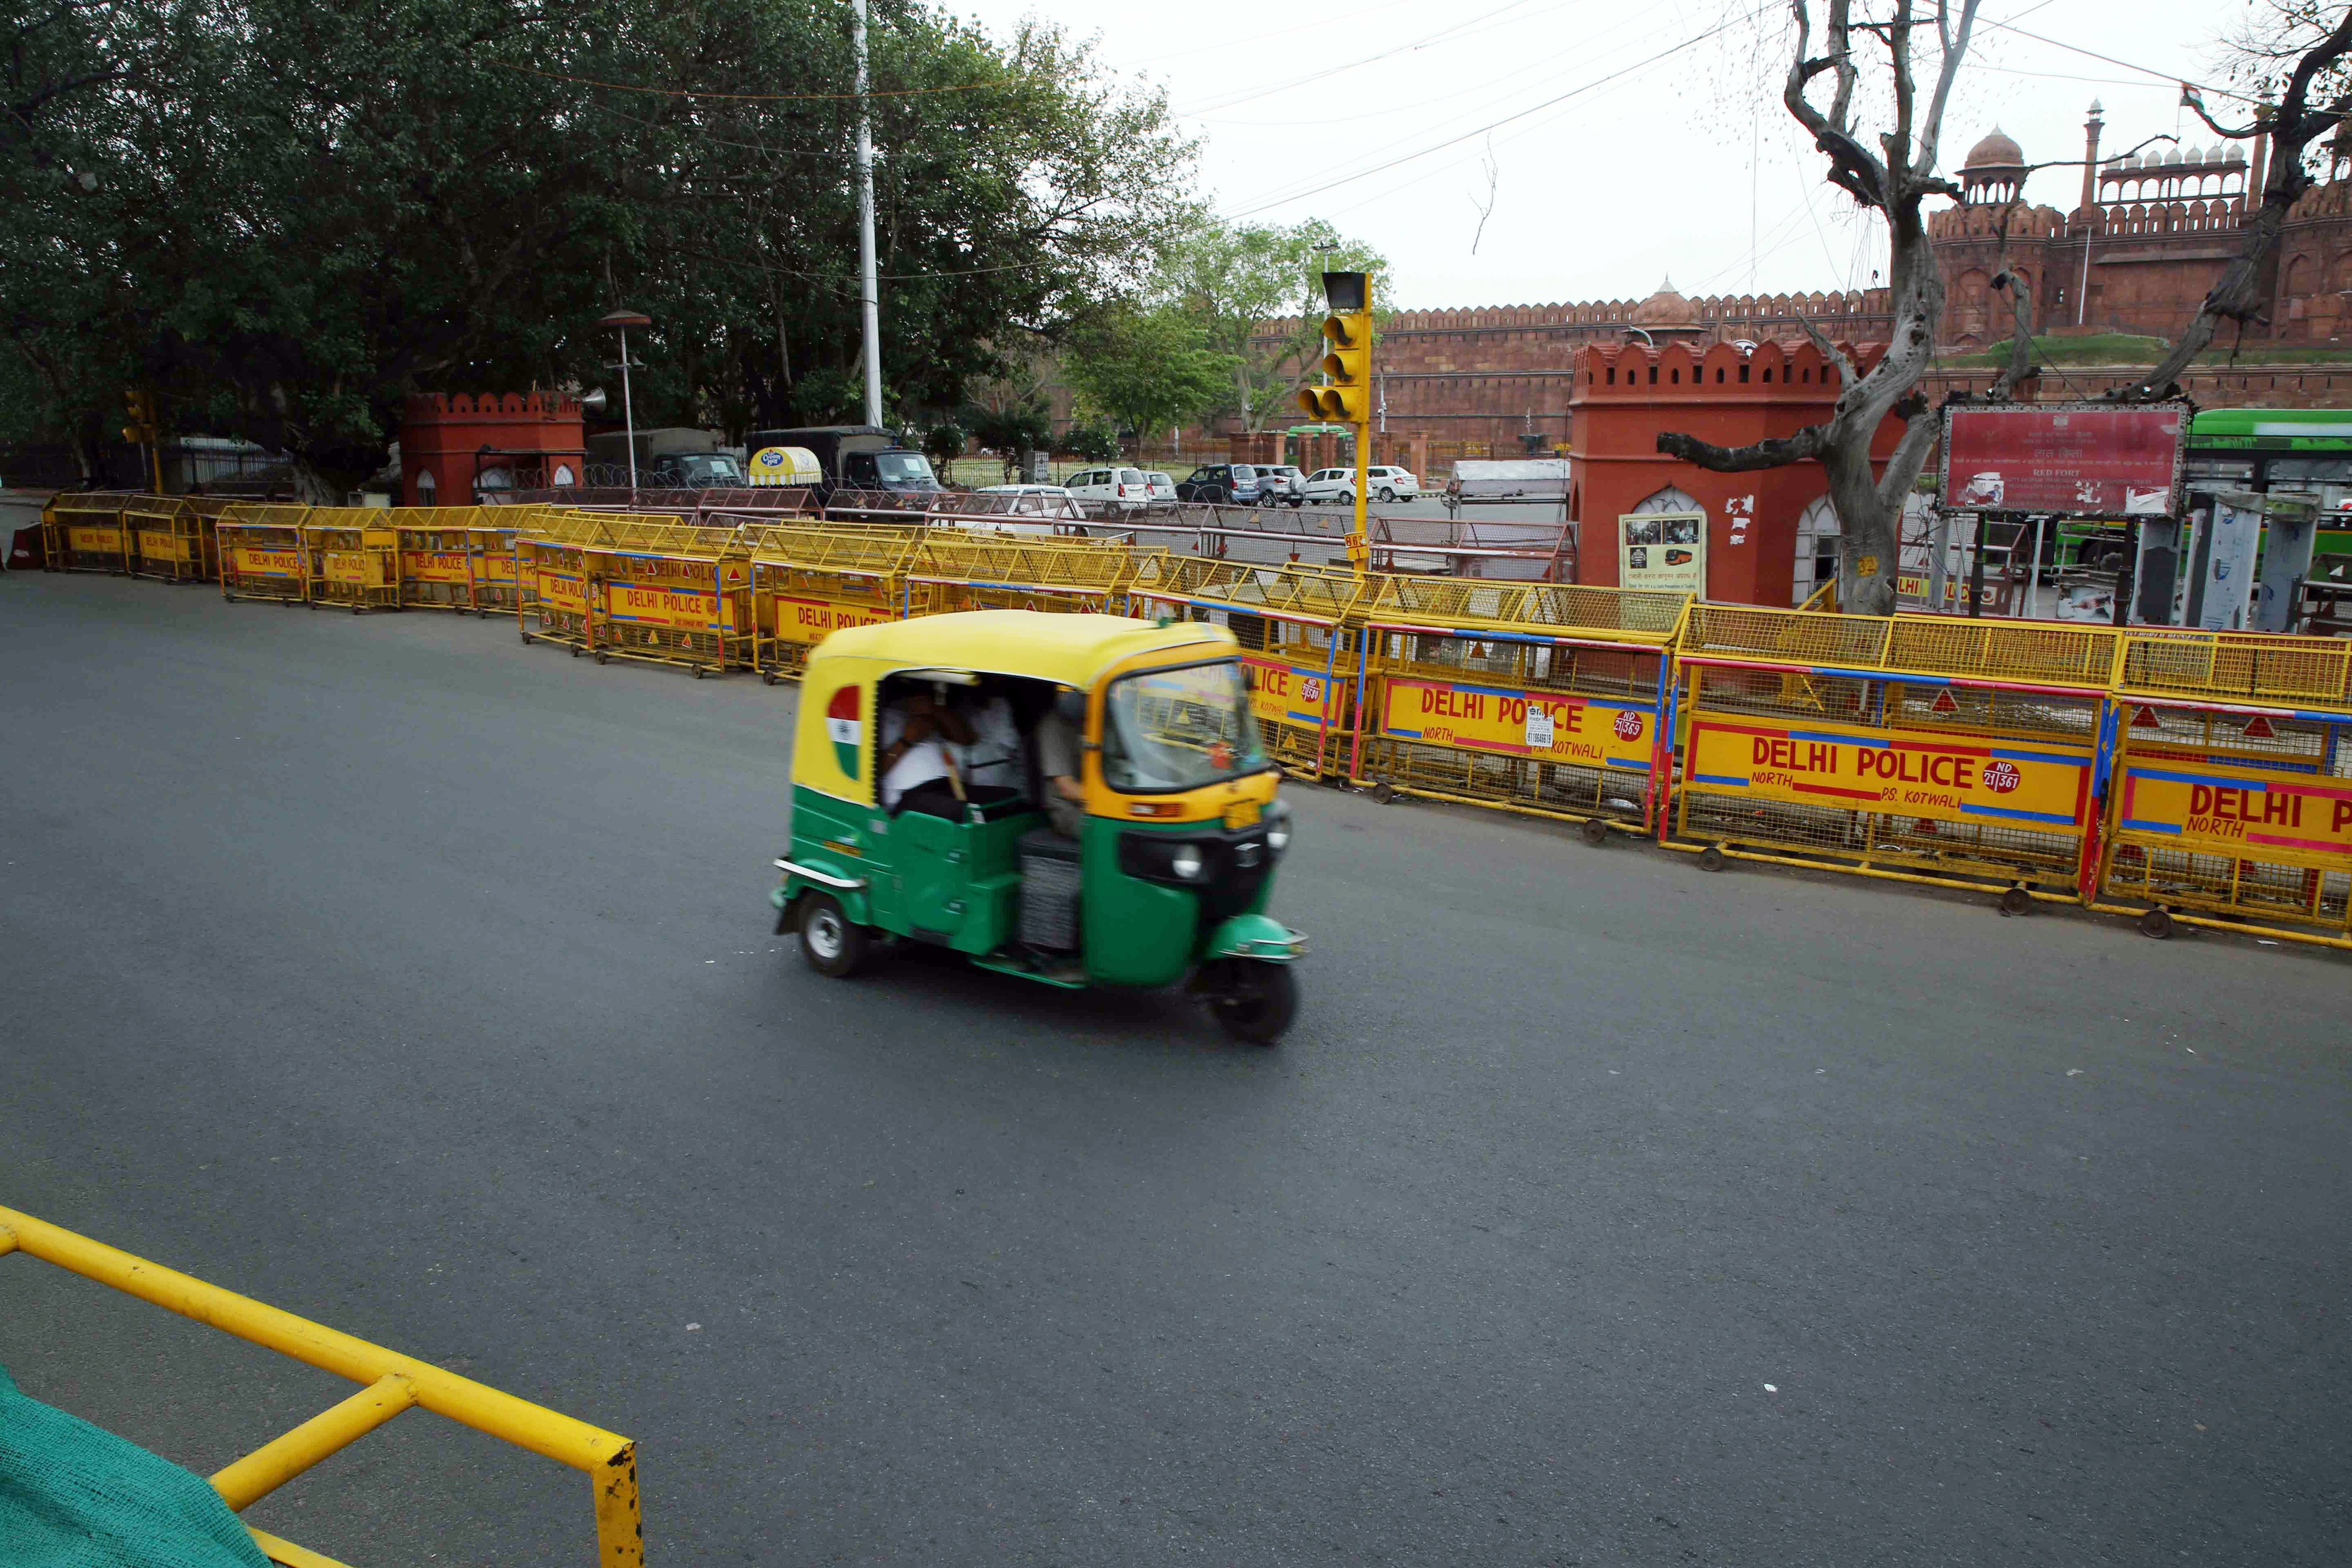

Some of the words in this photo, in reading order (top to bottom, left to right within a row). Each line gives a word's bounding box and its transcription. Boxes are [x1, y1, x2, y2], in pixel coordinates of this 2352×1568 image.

[248, 554, 270, 565] DELHI
[274, 555, 297, 569] POLICE
[416, 555, 435, 568] DELHI
[438, 557, 461, 570] POLICE
[550, 579, 567, 595] DELHI
[568, 581, 585, 598] POLIC
[1899, 579, 1919, 594] LHI
[627, 590, 658, 608] DELHI
[663, 594, 702, 614] POLICE
[798, 606, 832, 629] DELHI
[1421, 688, 1484, 720] DELHI
[1623, 711, 1636, 720] ND
[1422, 726, 1454, 741] NORTH
[1552, 739, 1603, 759] KOTWALI
[1753, 737, 1837, 774] DELHI
[1857, 748, 1975, 789] POLICE
[1996, 762, 2012, 773] ND
[1751, 771, 1793, 788] NORTH
[1999, 774, 2018, 789] 361
[1904, 790, 1962, 809] KOTWALI
[2189, 784, 2302, 828] DELHI
[2185, 816, 2245, 838] NORTH
